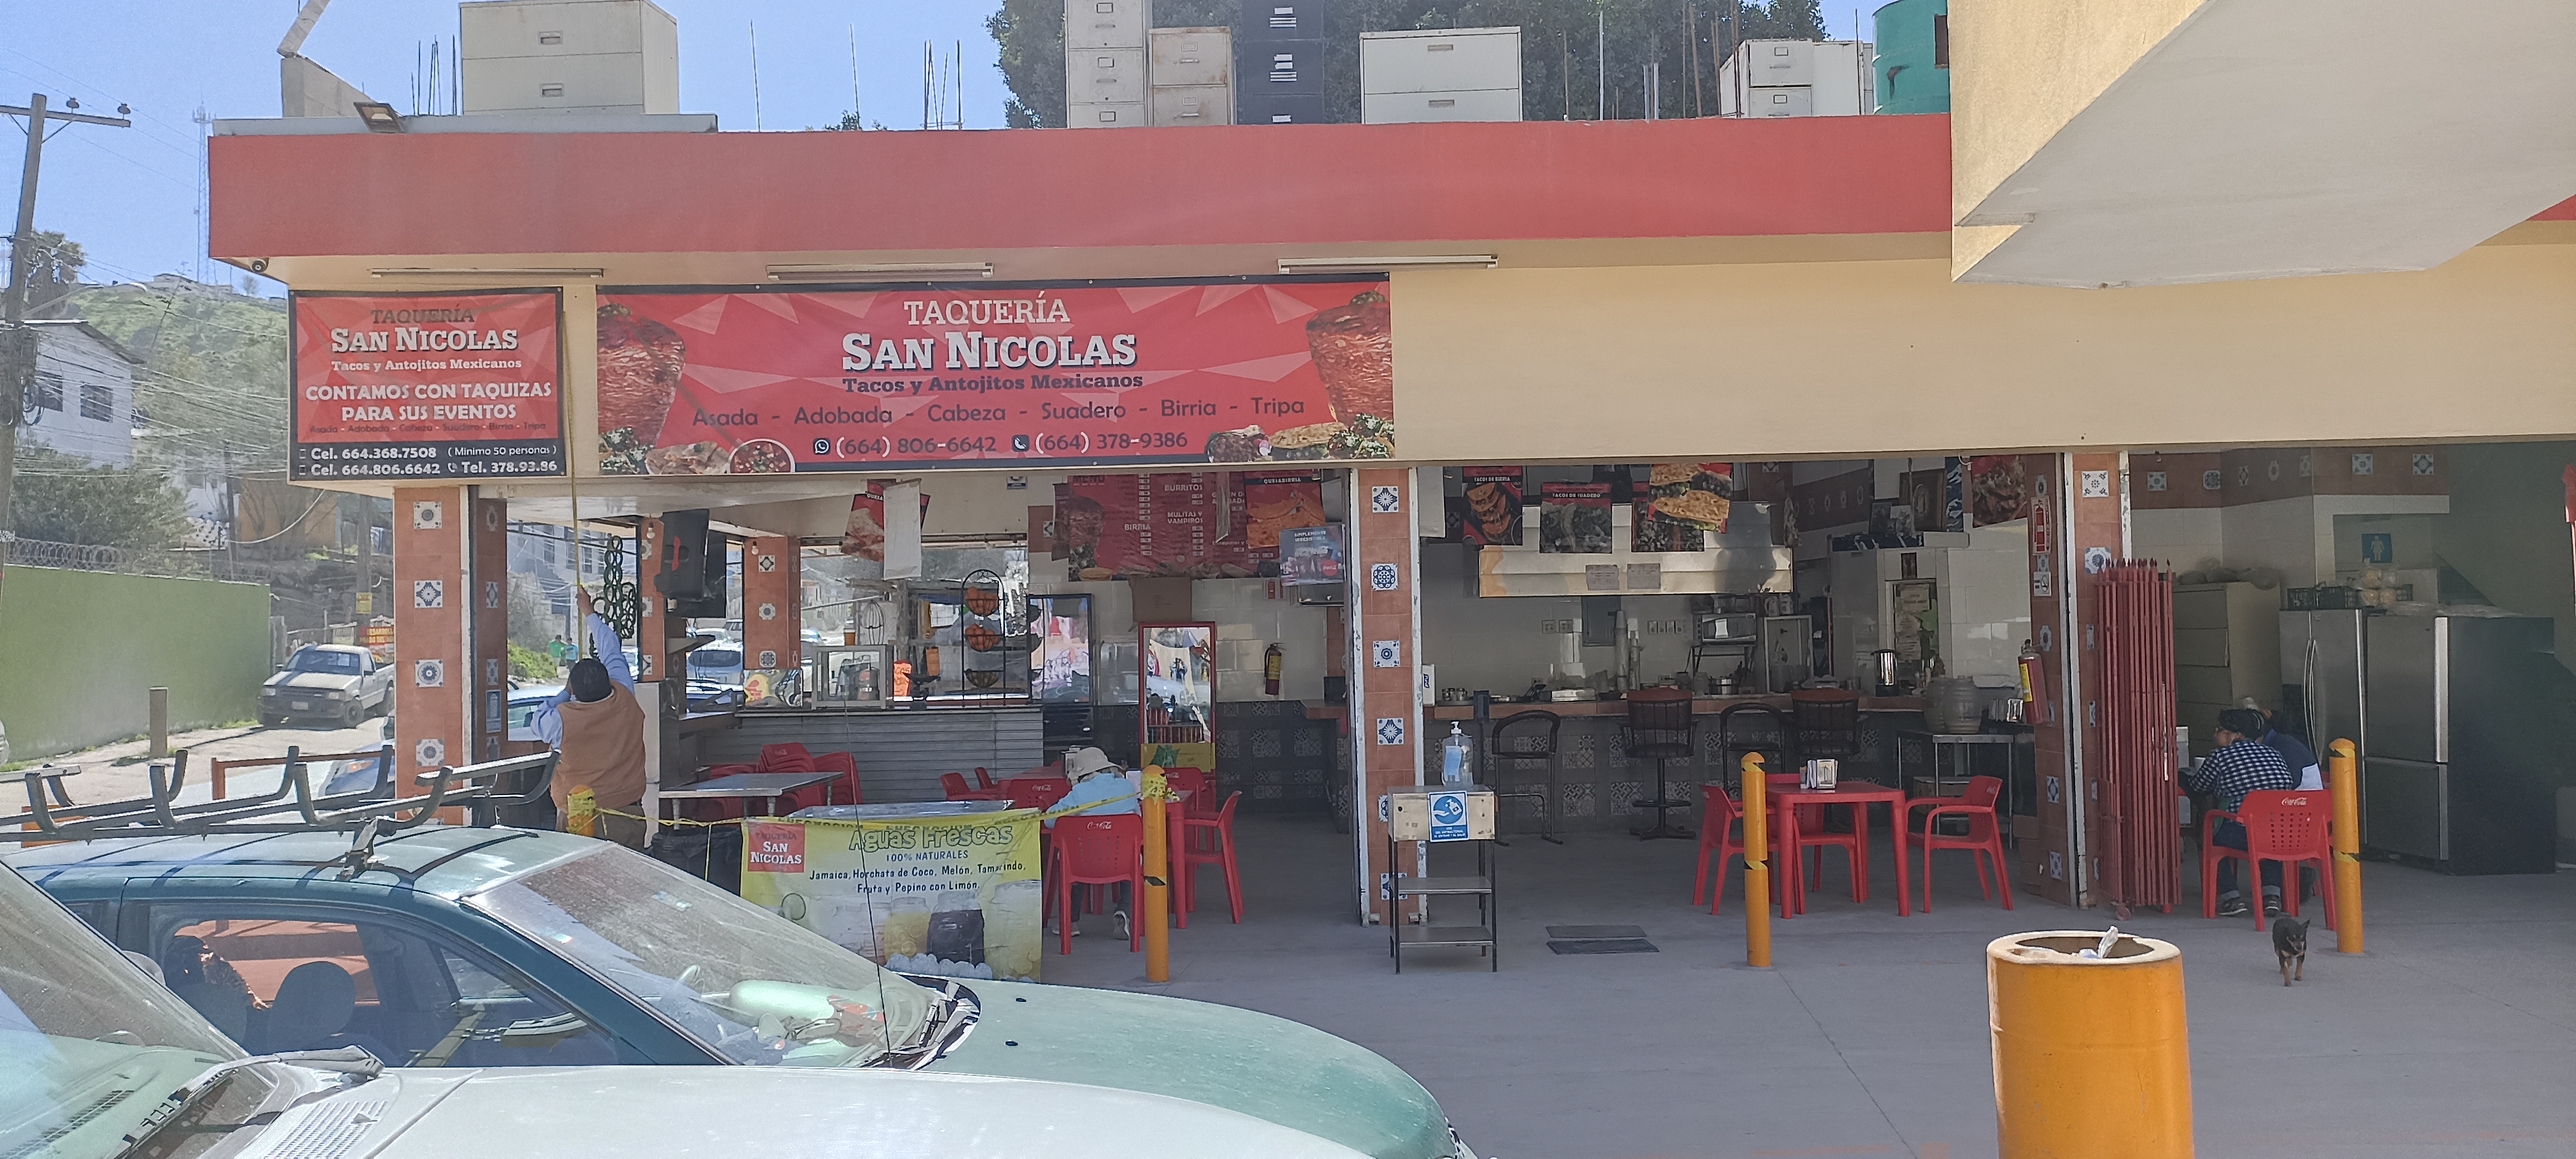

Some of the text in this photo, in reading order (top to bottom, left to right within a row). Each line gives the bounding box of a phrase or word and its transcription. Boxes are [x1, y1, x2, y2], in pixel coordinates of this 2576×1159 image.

[904, 290, 1070, 326] TAQUERÍA
[331, 358, 521, 372] Tacos y Antojitos Mexicanos
[305, 382, 552, 401] CONTAMOS CON TAQUIZAS
[842, 374, 1143, 395] Tacos y Antojitos Mexicanos
[341, 404, 516, 421] PARA SUS EVENTOS
[692, 408, 758, 426] Asada
[793, 406, 893, 425] Adobada
[927, 402, 1007, 422] Cabeza
[1041, 401, 1126, 420] Suadero
[1161, 398, 1217, 417] Birria
[1250, 397, 1305, 418] Tripa
[399, 423, 433, 432] Cabeza
[442, 423, 480, 431] Suadero
[494, 447, 506, 455] 50
[509, 447, 550, 456] personas
[836, 436, 997, 459] (664) 806-6642
[1035, 432, 1188, 454] (664) 378-9386
[310, 447, 437, 460] Cel. 664.368.7508
[310, 463, 441, 476] Cel. 664.806.6642
[461, 460, 557, 474] Tel. 378.93.86
[848, 825, 1013, 852] Aguas Frescas
[886, 850, 968, 861] 100% NATURALES
[853, 868, 895, 879] Horchata
[897, 868, 908, 876] de
[911, 866, 937, 876] Coco,
[941, 864, 973, 875] Melón,
[977, 860, 1026, 874] Tamarindo,
[857, 883, 882, 893] Fruta
[885, 885, 890, 895] y
[895, 882, 926, 894] Pepino
[929, 883, 945, 891] con
